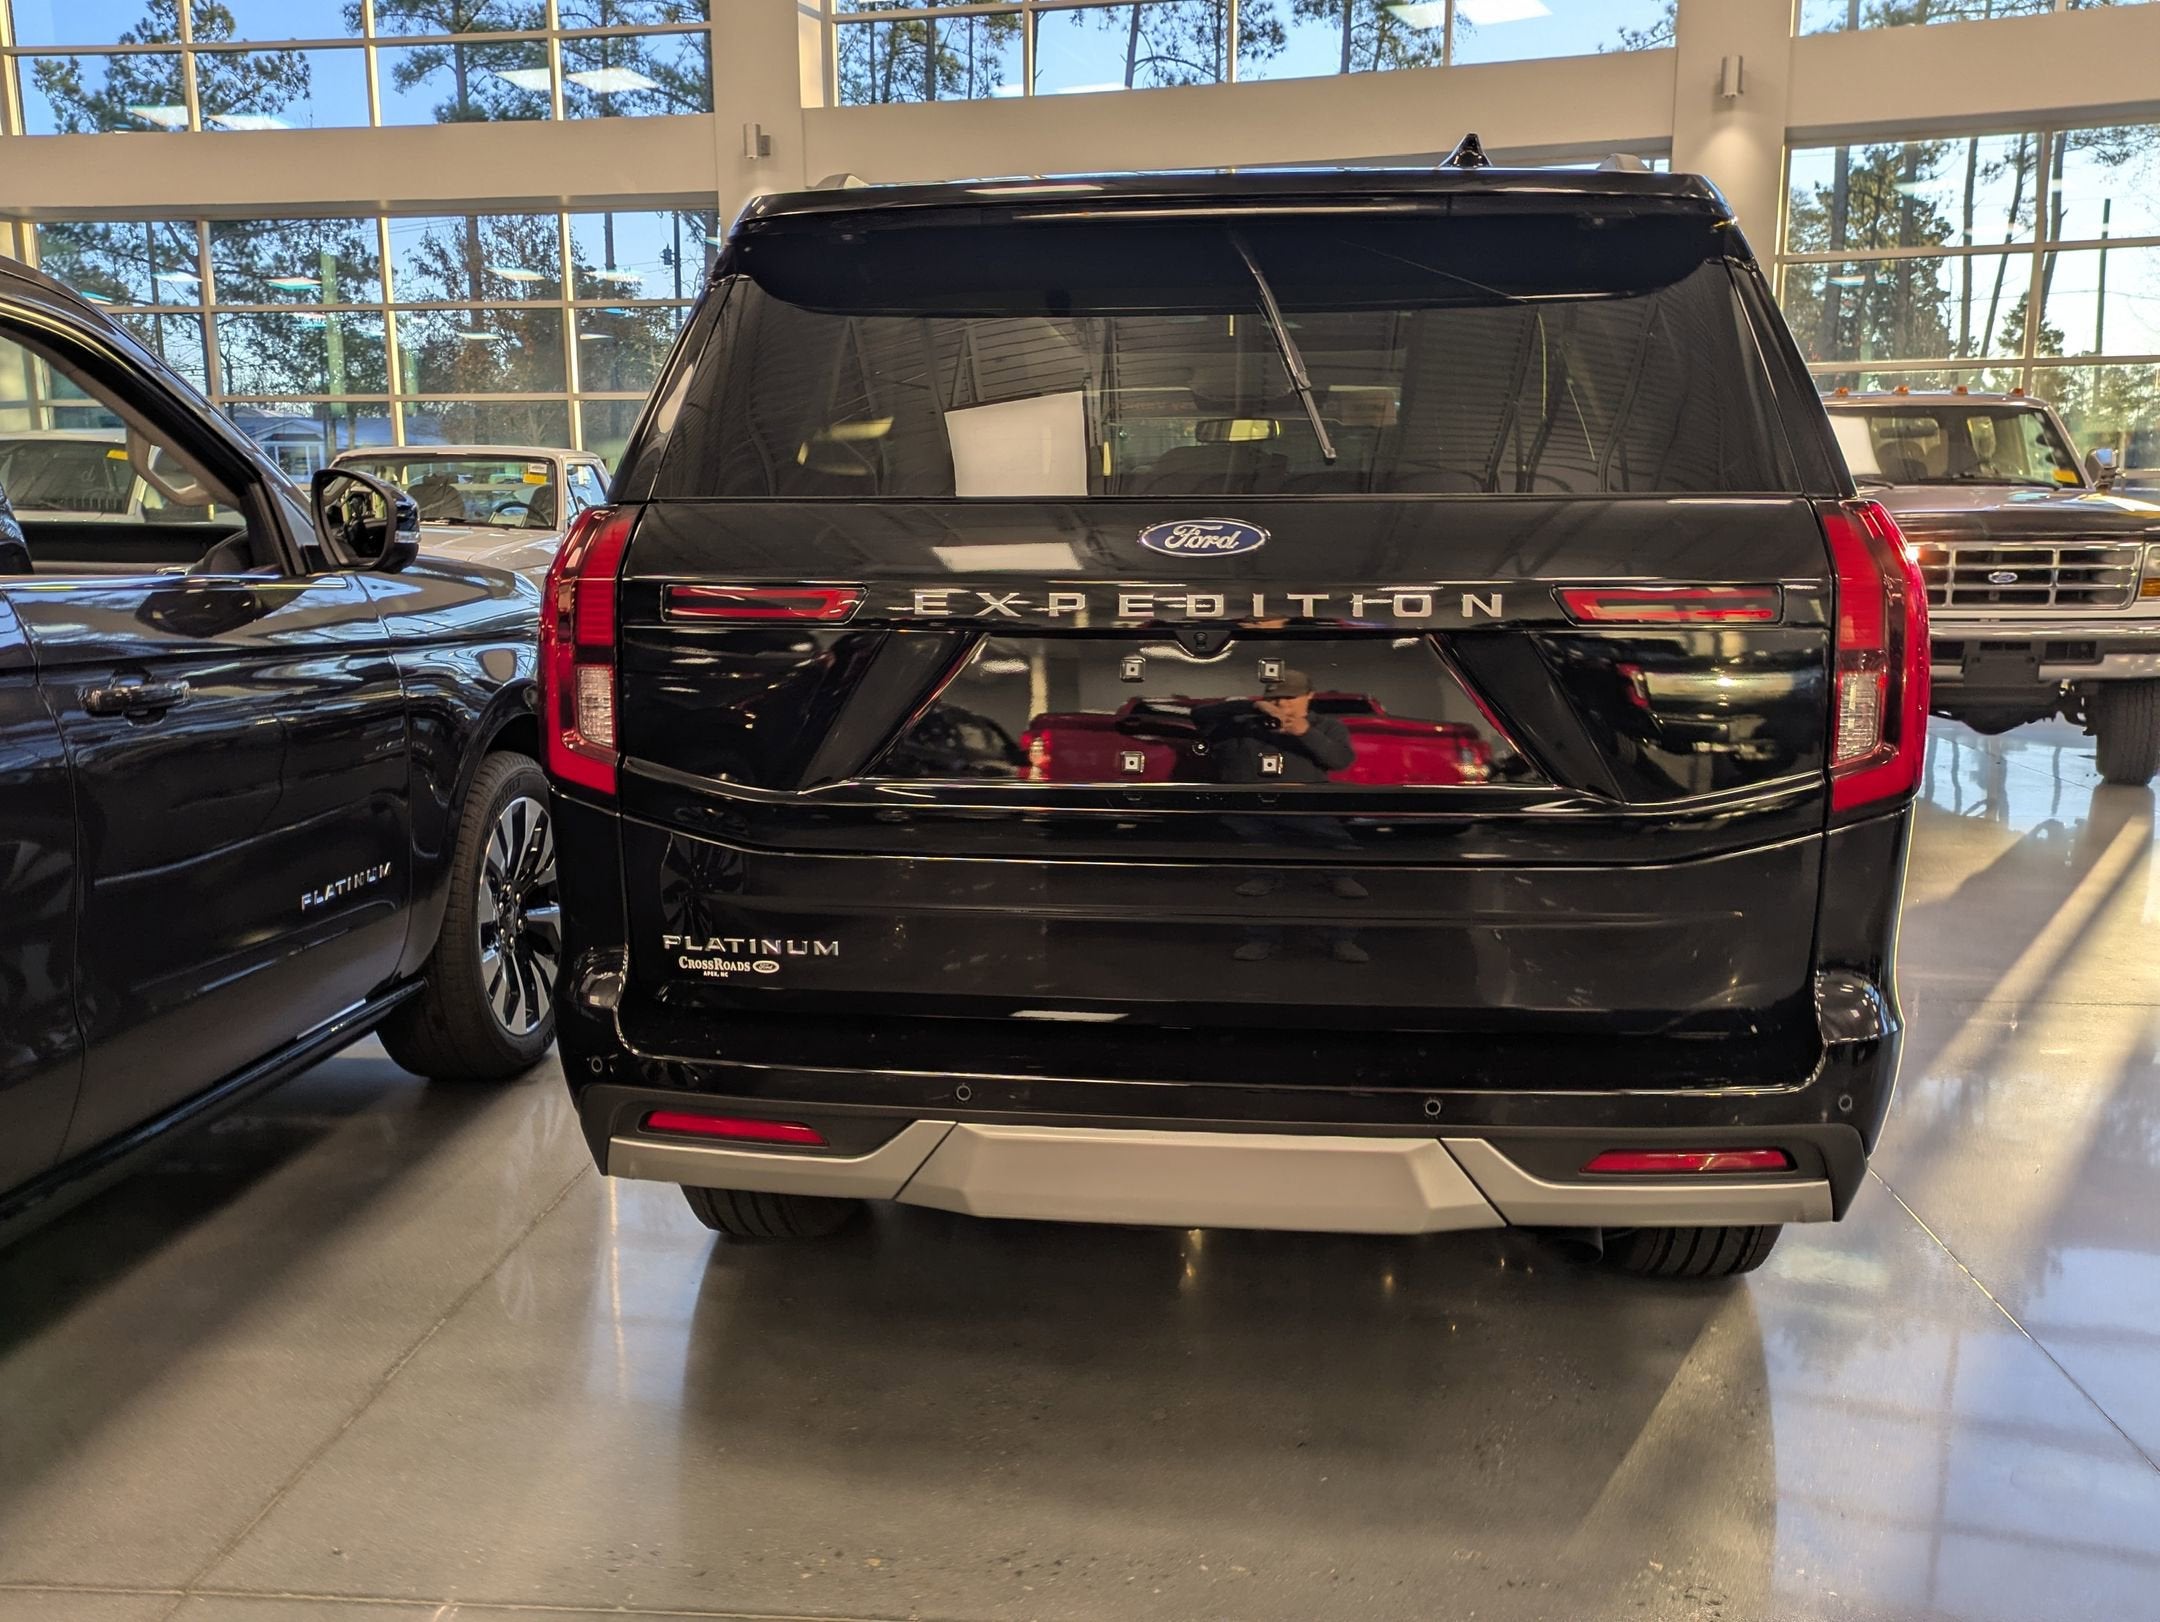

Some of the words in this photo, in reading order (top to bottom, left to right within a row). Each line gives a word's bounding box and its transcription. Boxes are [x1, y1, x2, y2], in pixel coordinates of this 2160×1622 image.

[1164, 523, 1242, 549] Ford
[913, 592, 1504, 619] EXPEDITION
[301, 861, 391, 911] PLATINUM
[662, 934, 839, 956] PLATINUM
